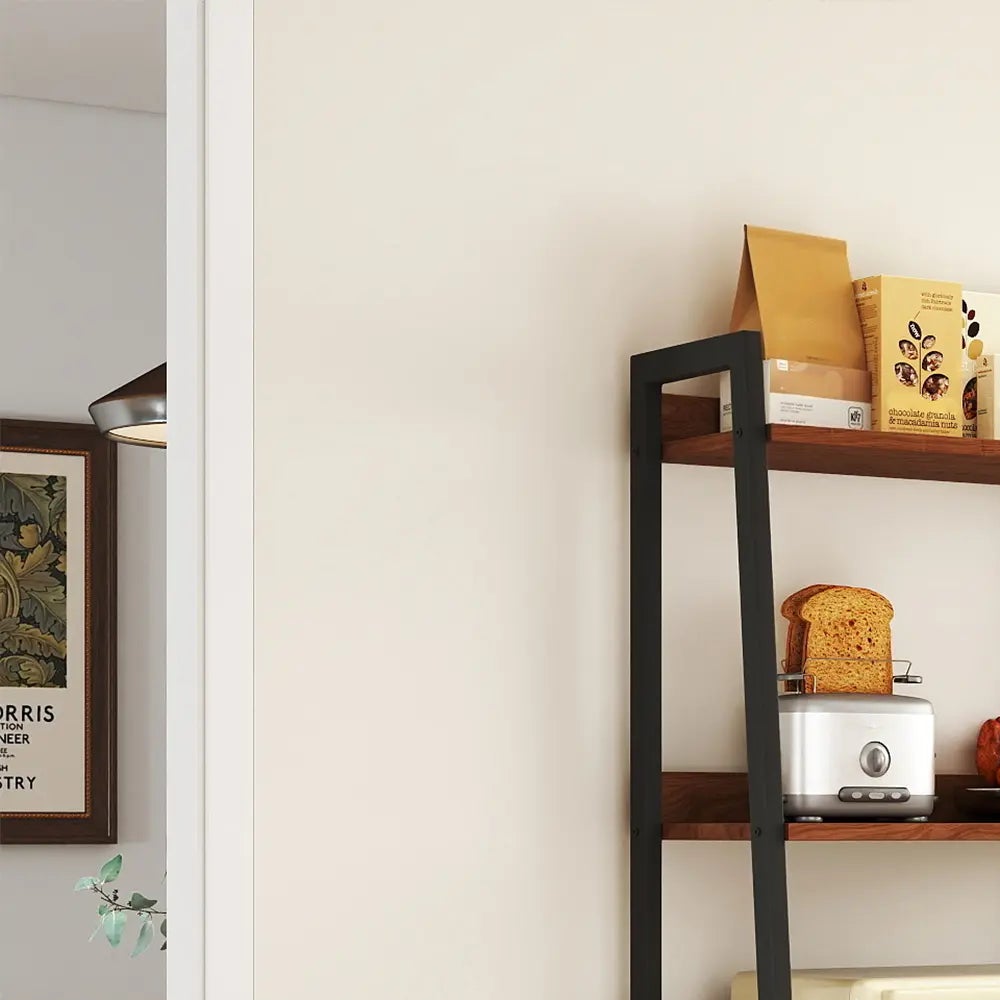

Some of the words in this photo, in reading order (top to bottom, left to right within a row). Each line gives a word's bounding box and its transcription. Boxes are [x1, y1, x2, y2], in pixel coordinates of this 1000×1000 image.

[888, 408, 925, 418] chocolate
[926, 411, 956, 420] granola
[888, 416, 896, 425] &
[897, 418, 940, 428] macadamia
[941, 421, 958, 429] nuts
[0, 705, 54, 722] RRIS
[0, 723, 24, 731] TION
[0, 776, 36, 790] TRY
